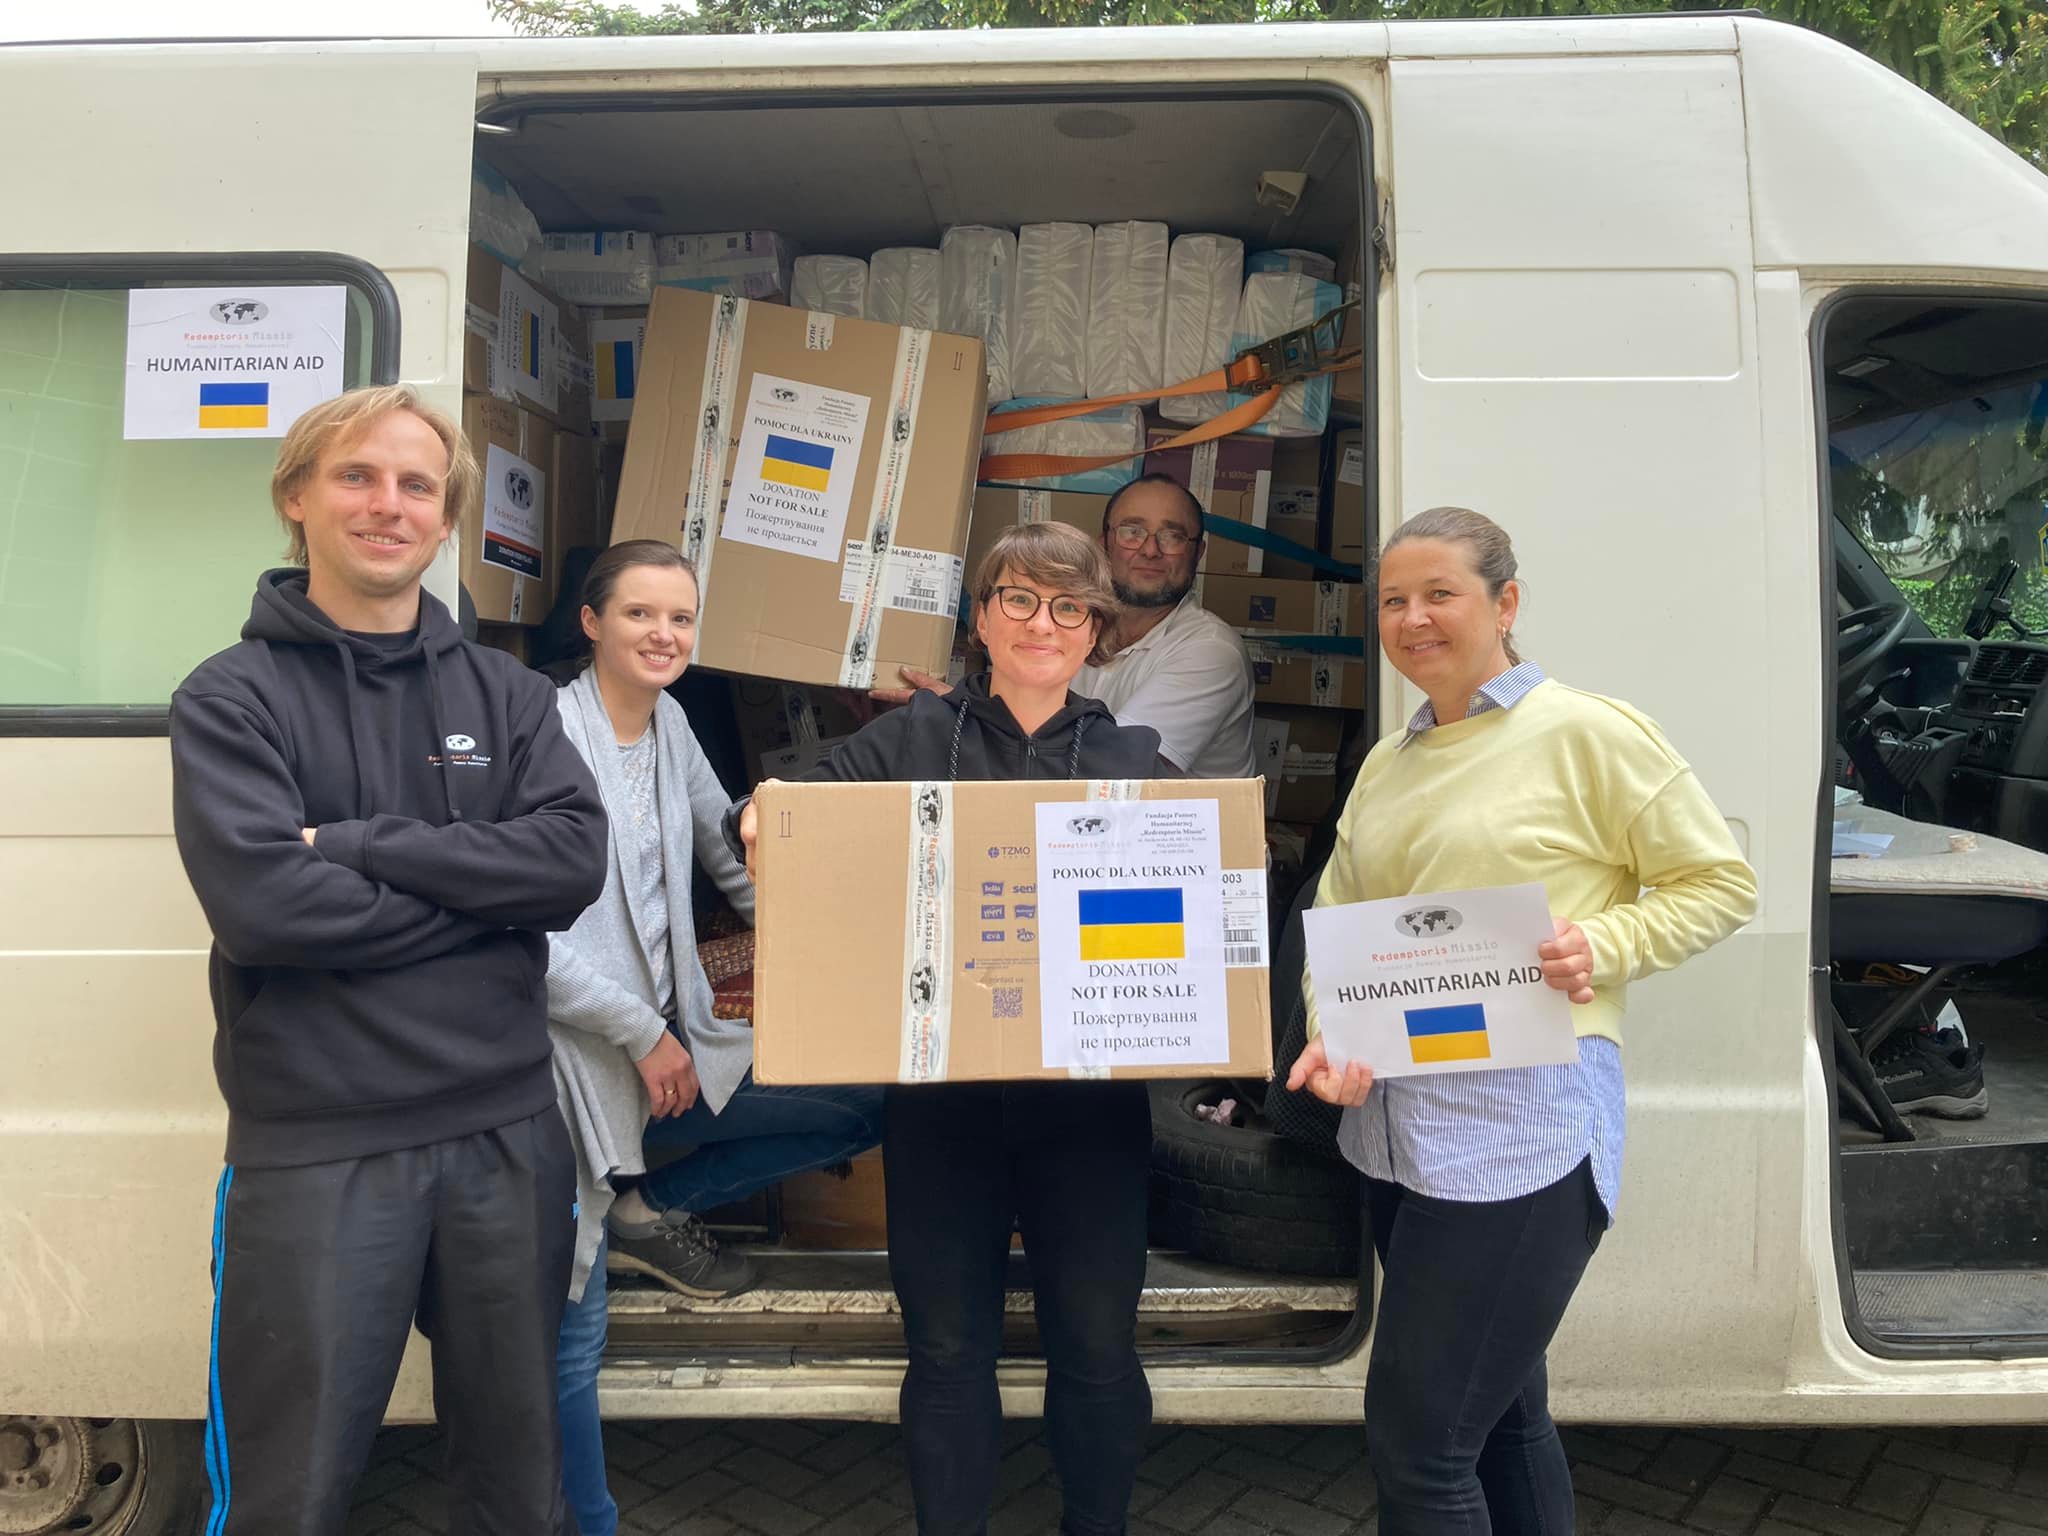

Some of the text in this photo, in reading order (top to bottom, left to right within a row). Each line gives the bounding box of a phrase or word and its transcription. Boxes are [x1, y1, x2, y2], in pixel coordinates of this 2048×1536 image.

[146, 355, 324, 372] HUMANITARIAN AID
[754, 415, 854, 445] POMOC DLA UKRAINY
[762, 482, 820, 501] DONATION
[749, 493, 830, 518] NOT FOR SALE
[745, 508, 825, 534] Пожертвування
[746, 526, 759, 535] не
[1001, 846, 1031, 855] TZMO
[1052, 864, 1208, 880] POMOC DLA UKRAINY
[1222, 873, 1242, 883] 003
[925, 912, 935, 951] Missio
[1372, 940, 1498, 962] Redemptoris Missio
[1089, 962, 1178, 978] DONATION
[1071, 984, 1197, 1000] NOT FOR SALE
[1338, 966, 1542, 1003] HUMANITARIAN AID
[1073, 1010, 1198, 1028] Пожертвування
[1081, 1037, 1098, 1049] не
